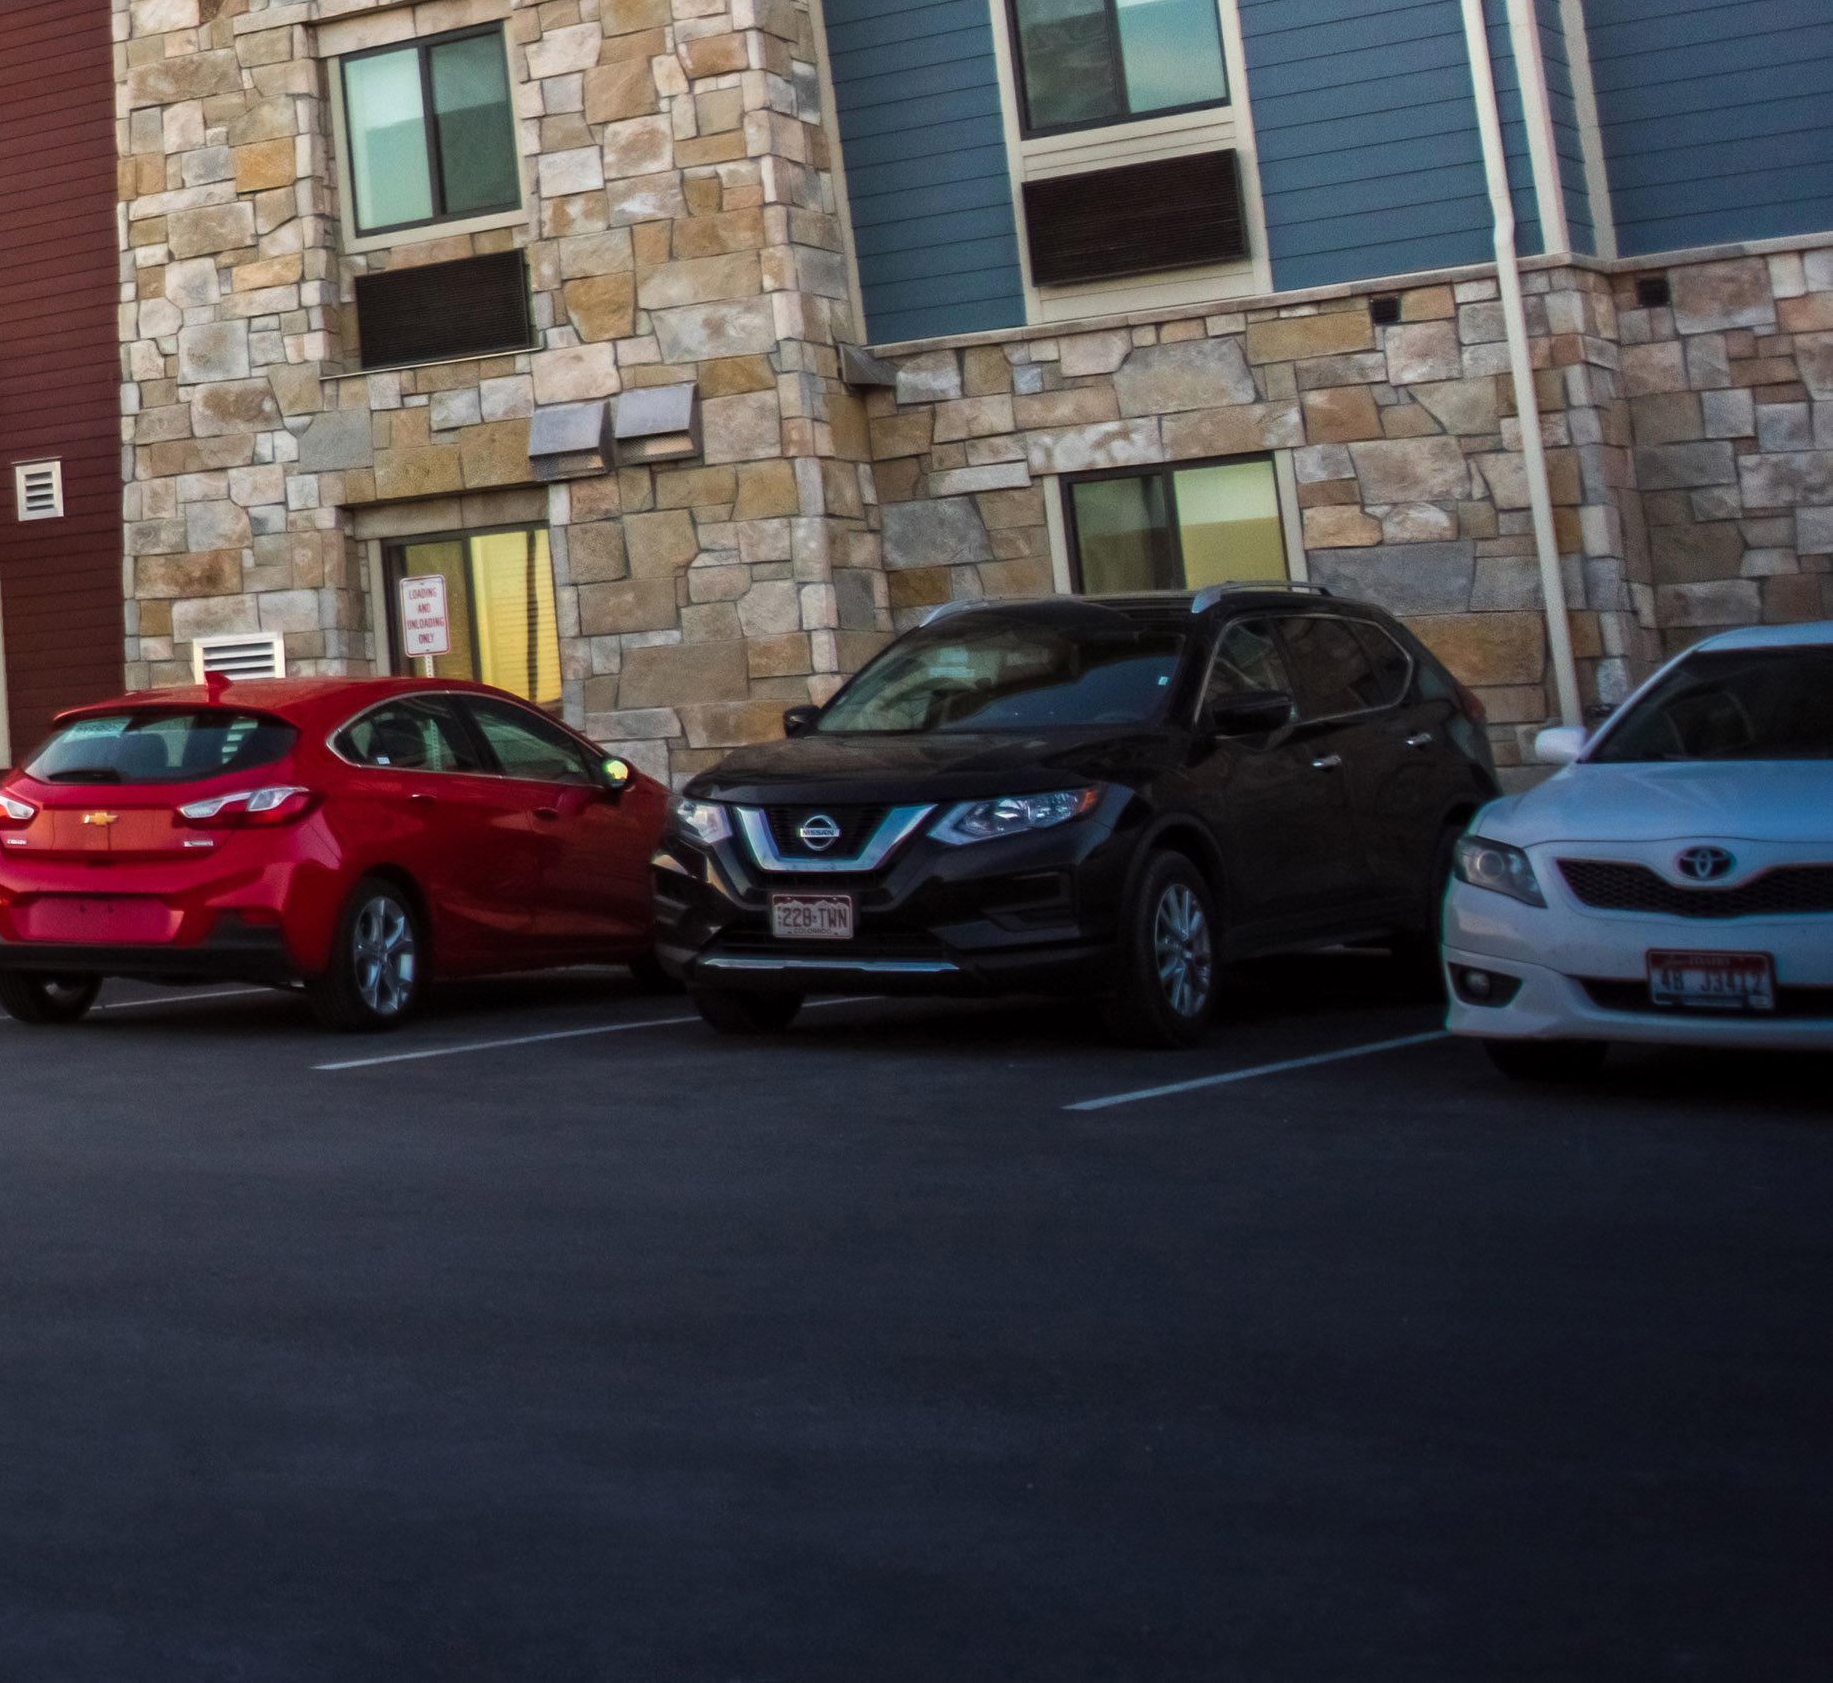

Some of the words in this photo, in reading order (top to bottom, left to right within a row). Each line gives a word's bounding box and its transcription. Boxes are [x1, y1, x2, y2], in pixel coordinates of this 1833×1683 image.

[409, 587, 437, 600] LOADING
[417, 603, 431, 614] AND
[407, 617, 445, 630] UNLOADING
[418, 632, 434, 644] ONLY
